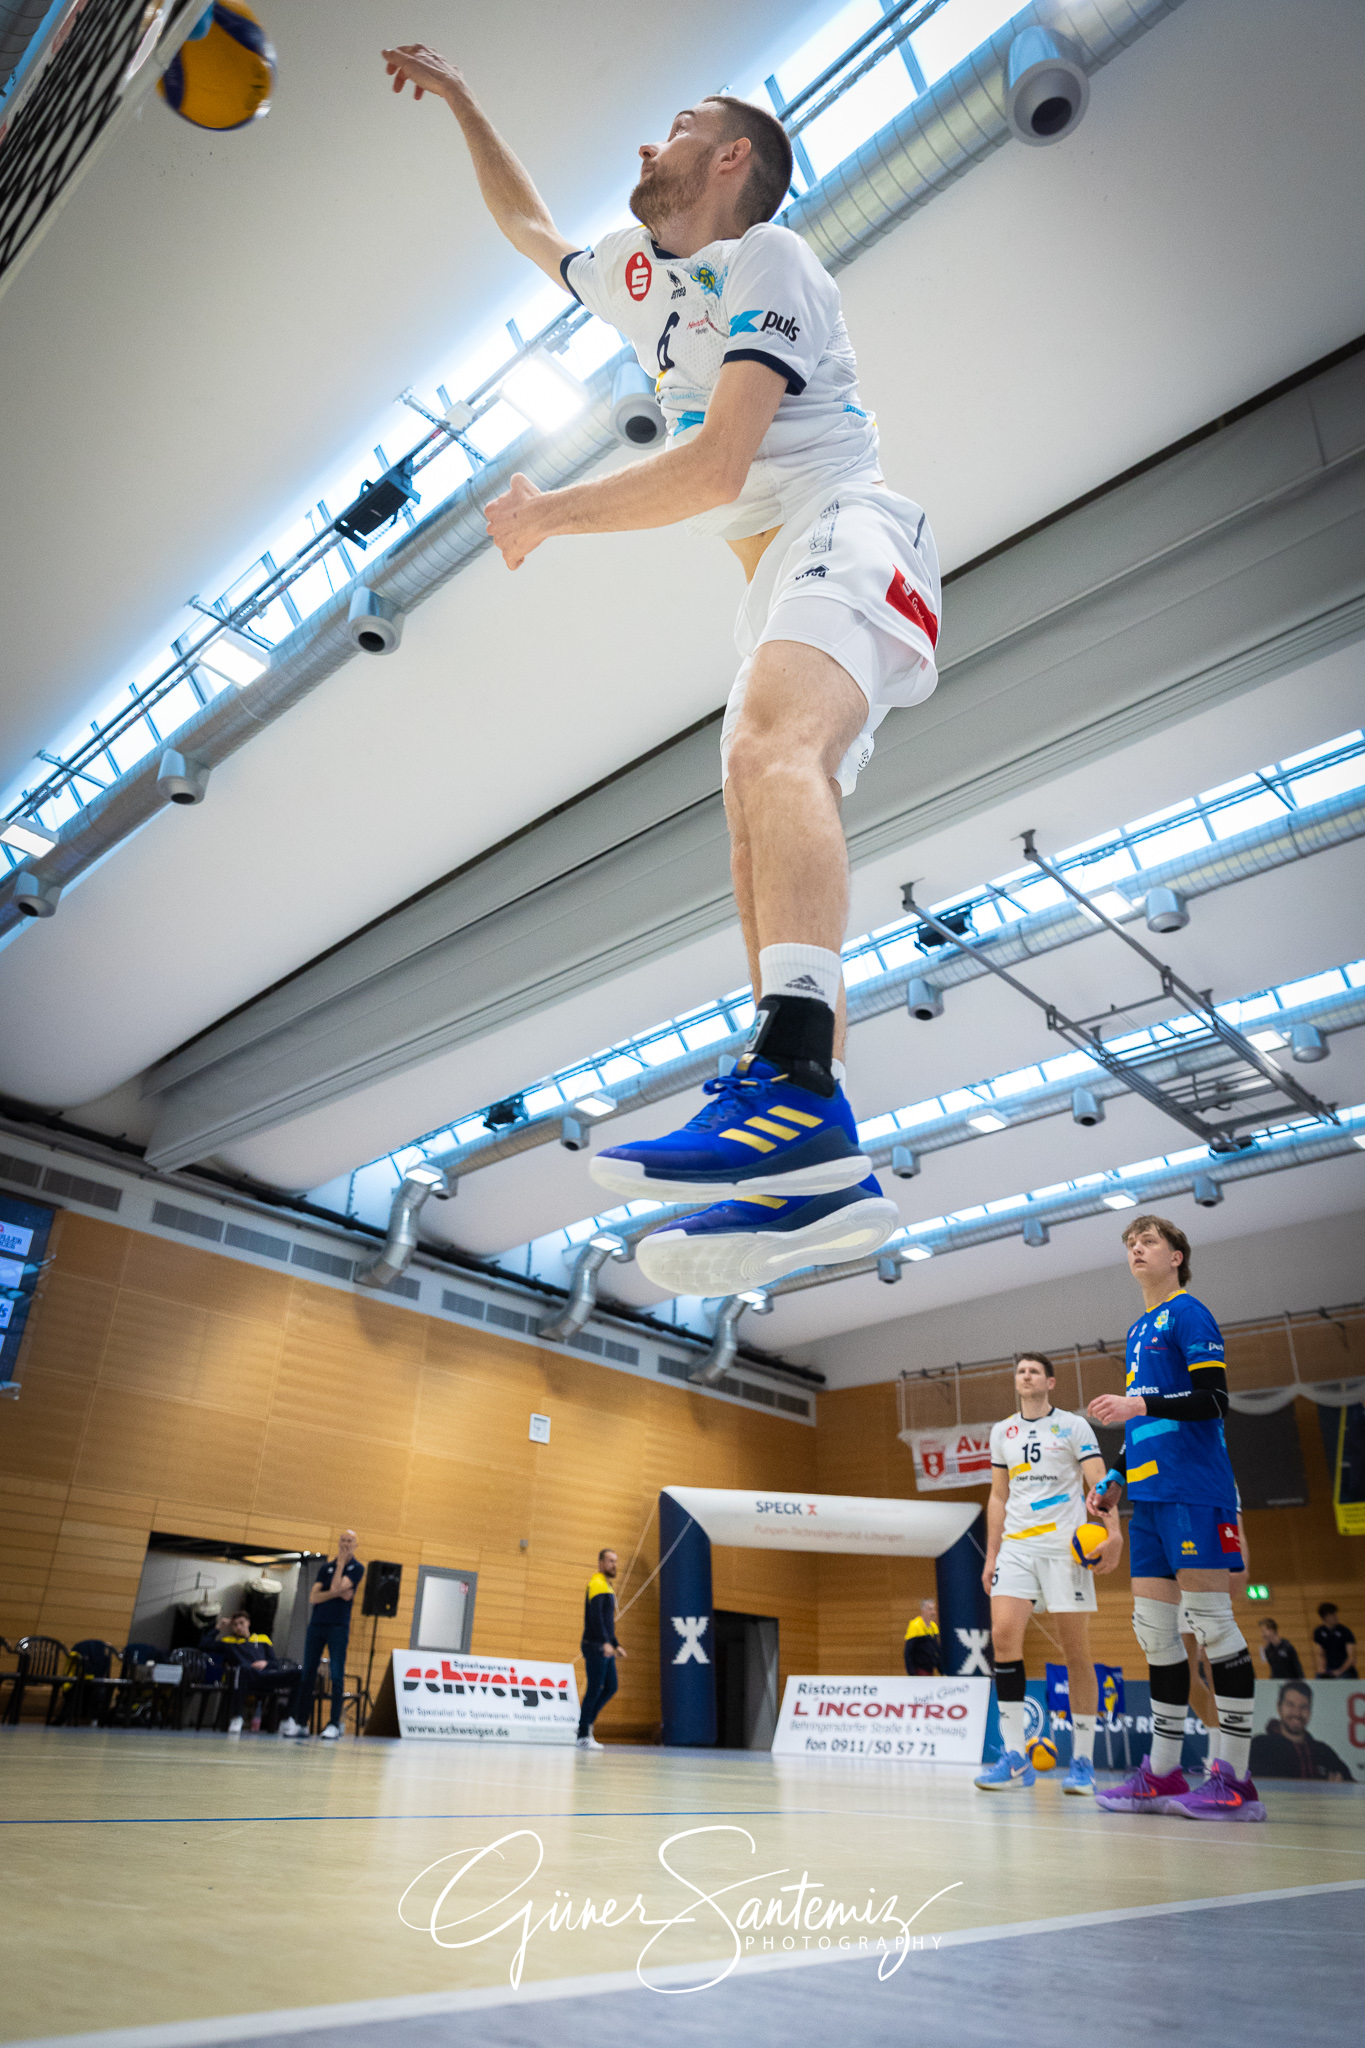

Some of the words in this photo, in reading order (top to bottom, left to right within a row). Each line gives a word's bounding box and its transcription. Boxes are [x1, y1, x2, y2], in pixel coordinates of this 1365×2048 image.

[760, 310, 801, 342] puls
[1022, 1442, 1042, 1464] 15
[755, 1501, 803, 1516] SPECK
[403, 1660, 569, 1707] schweiger
[797, 1682, 878, 1697] Ristorante
[407, 1723, 510, 1738] www.schweiger.de
[806, 1737, 827, 1751] fon
[831, 1739, 892, 1757] 0911/50
[899, 1741, 914, 1755] 57
[920, 1742, 936, 1756] 71
